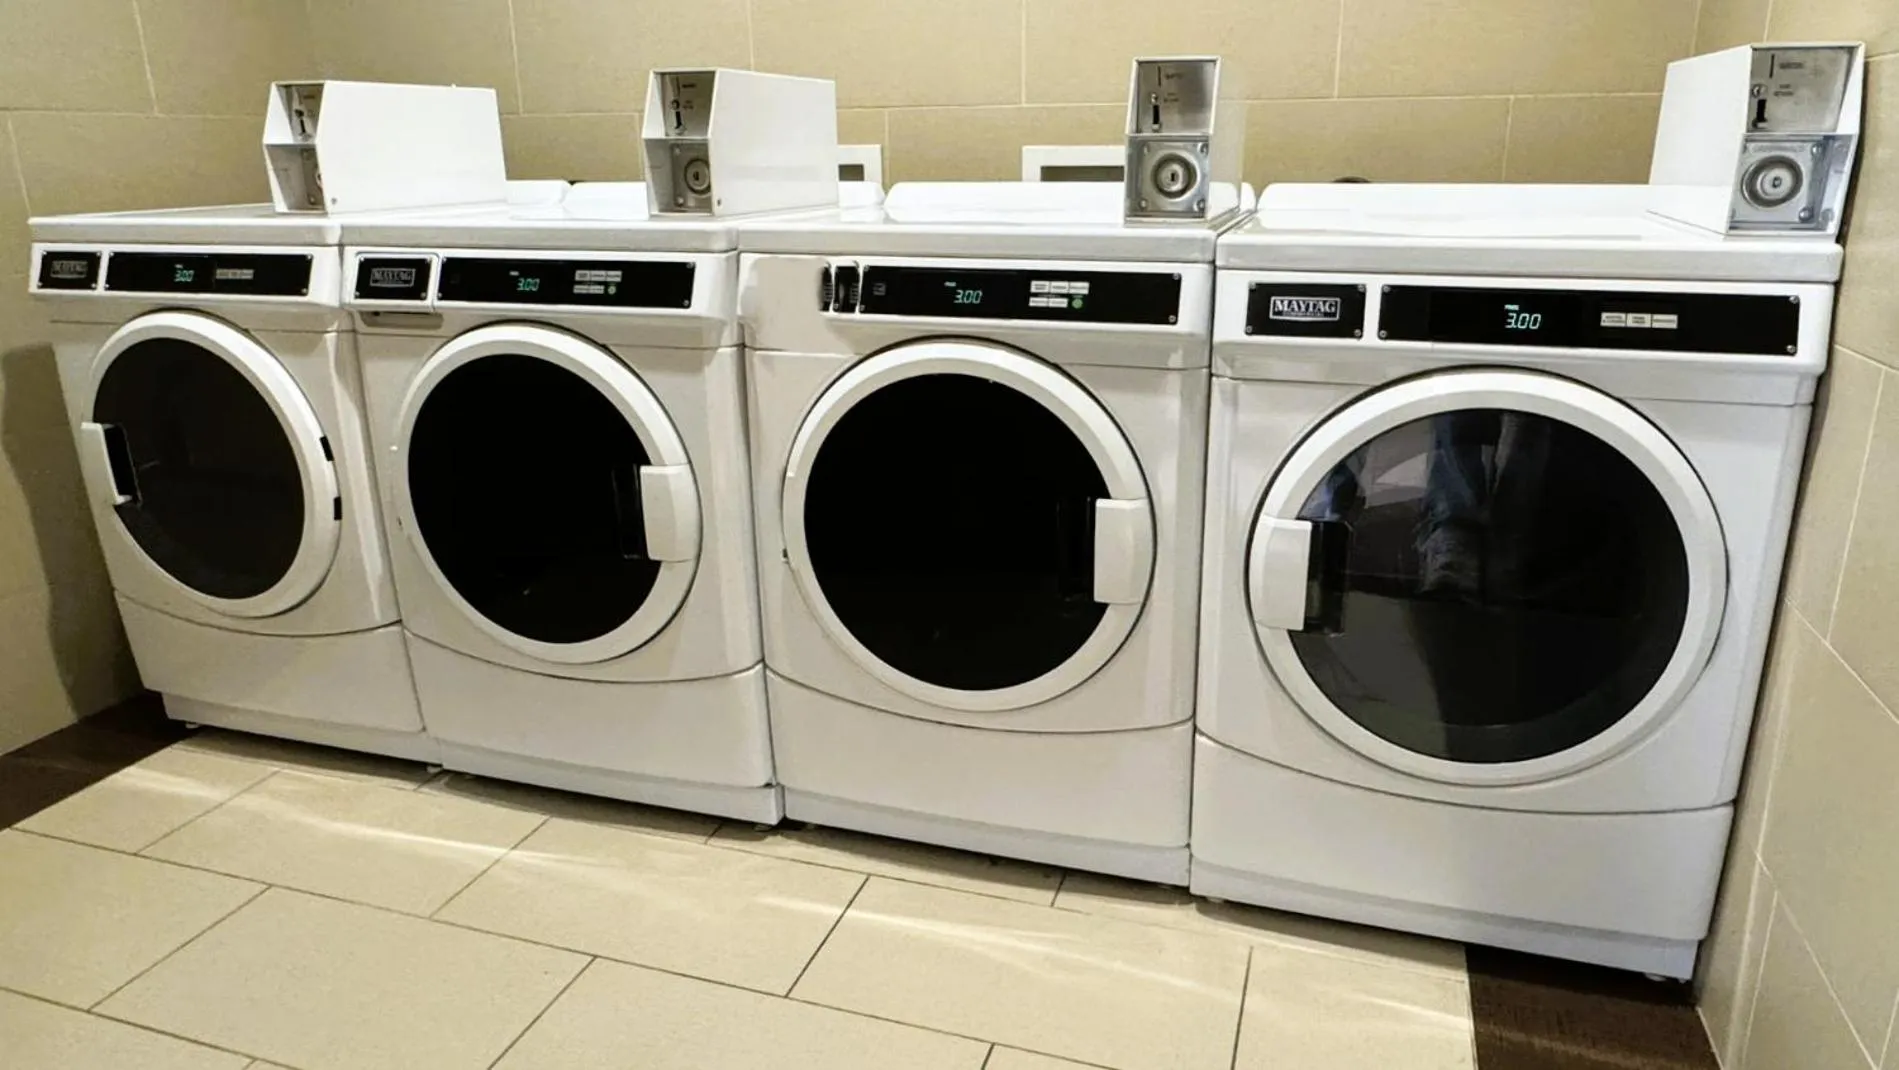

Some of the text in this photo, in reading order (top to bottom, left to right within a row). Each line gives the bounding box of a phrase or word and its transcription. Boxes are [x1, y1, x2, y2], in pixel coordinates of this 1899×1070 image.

[517, 277, 540, 291] 3.00
[954, 289, 982, 304] 3.00
[1274, 299, 1336, 313] MAYTAG
[1505, 313, 1541, 329] 3.00
